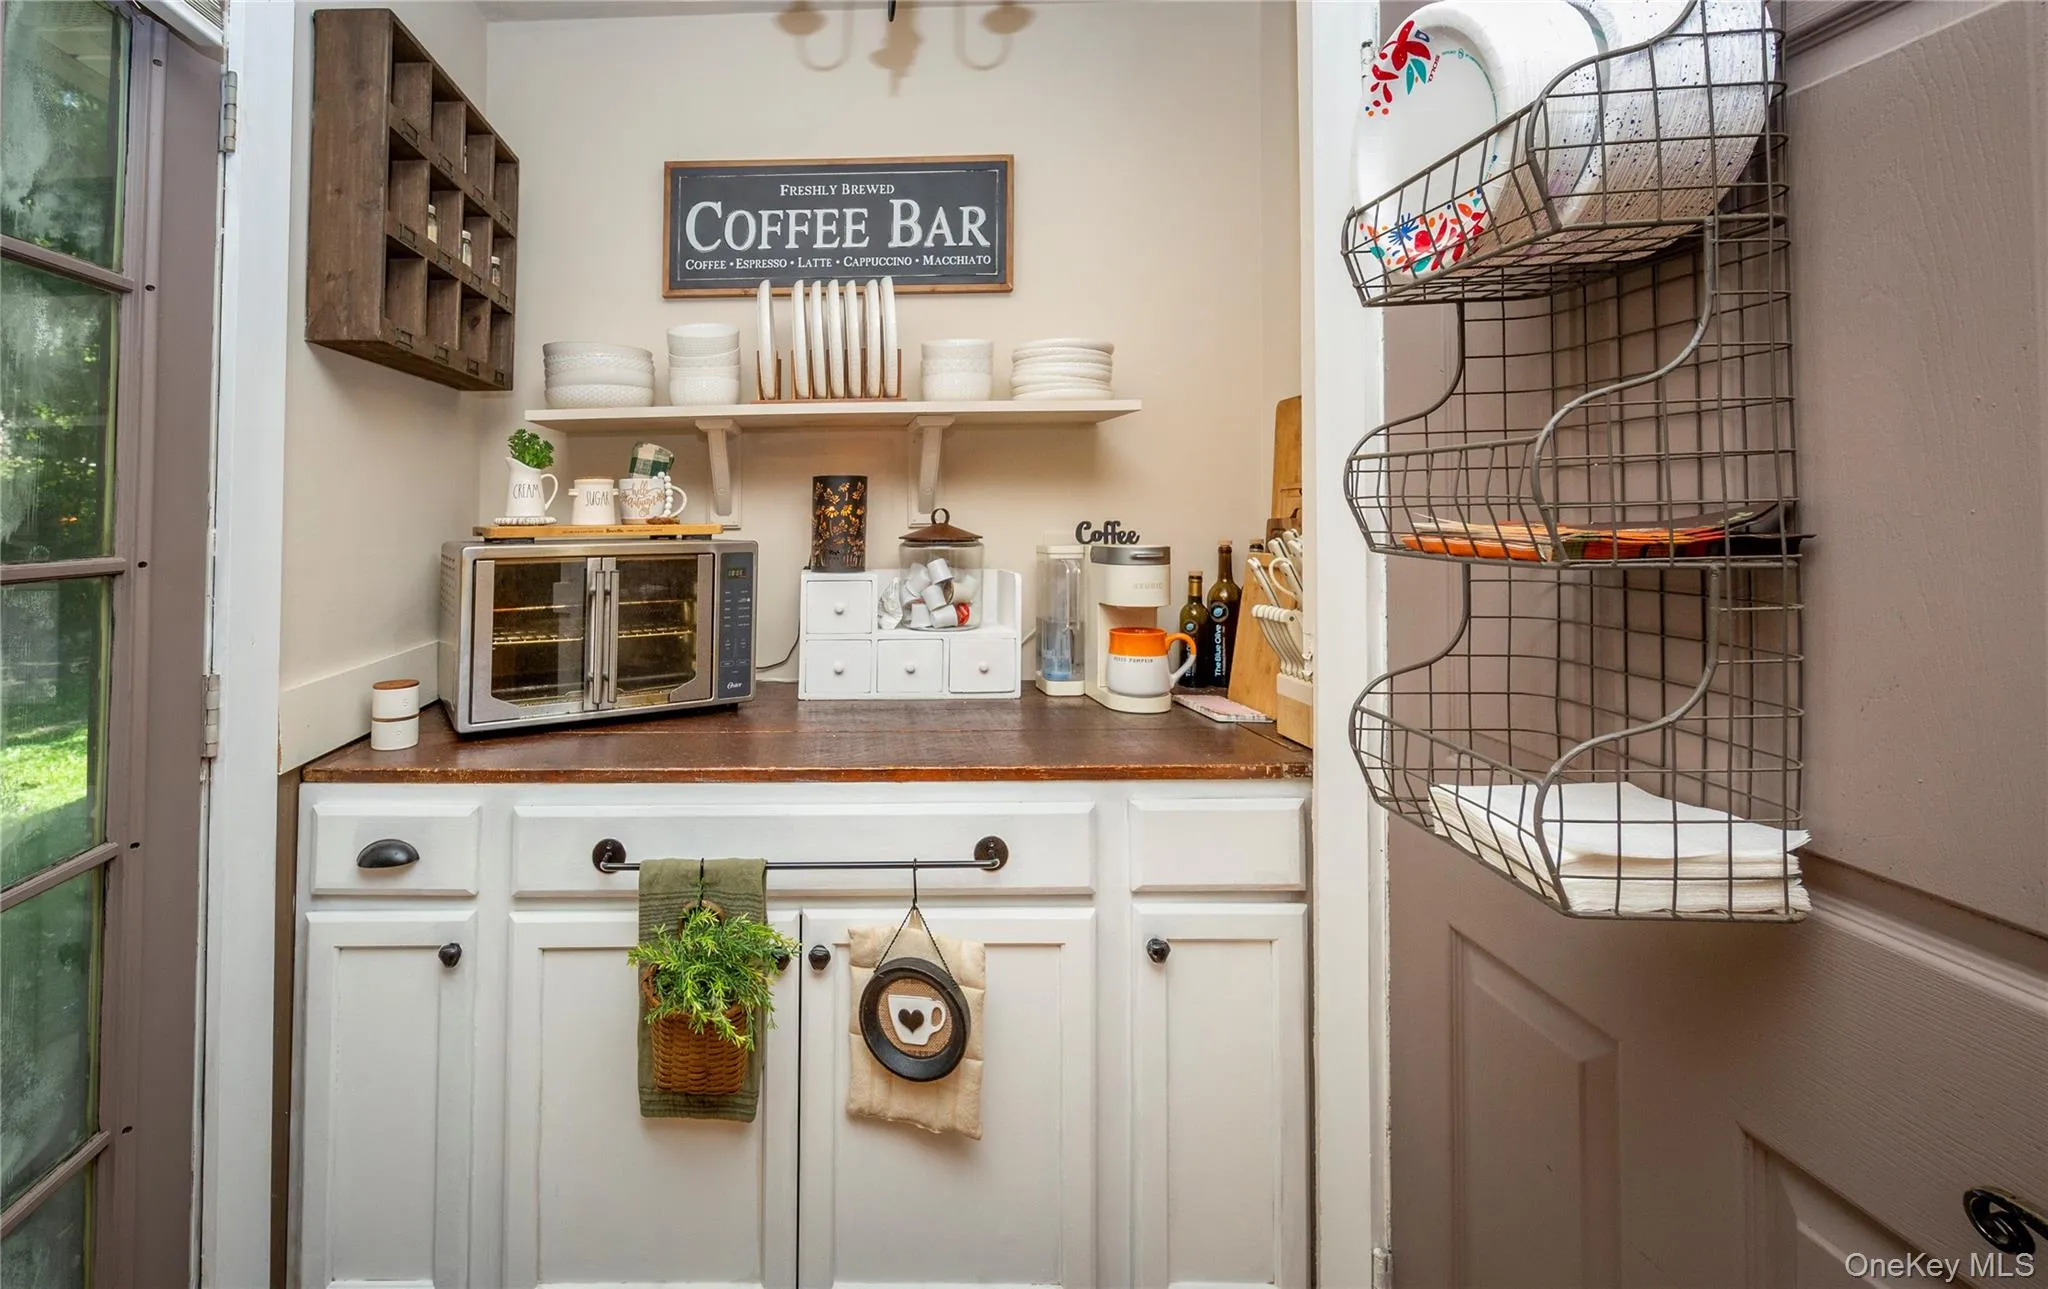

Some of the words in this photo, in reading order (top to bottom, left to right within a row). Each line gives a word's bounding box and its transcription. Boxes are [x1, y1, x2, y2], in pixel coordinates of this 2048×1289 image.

[780, 184, 838, 196] FRESHLY
[841, 183, 895, 195] BREWED
[685, 200, 870, 253] COFFEE
[887, 199, 991, 248] BAR
[685, 259, 727, 271] COFFEE
[735, 257, 788, 269] ESPRESSO
[798, 256, 832, 268] LATTE
[843, 255, 912, 267] CAPPUCCINO
[922, 254, 991, 266] MACCHIATO
[512, 483, 541, 499] CREAM
[585, 489, 610, 506] SUGAR
[1075, 520, 1140, 545] Coffee
[1214, 624, 1222, 644] Olive
[1214, 644, 1222, 661] Blue
[1214, 661, 1222, 677] The
